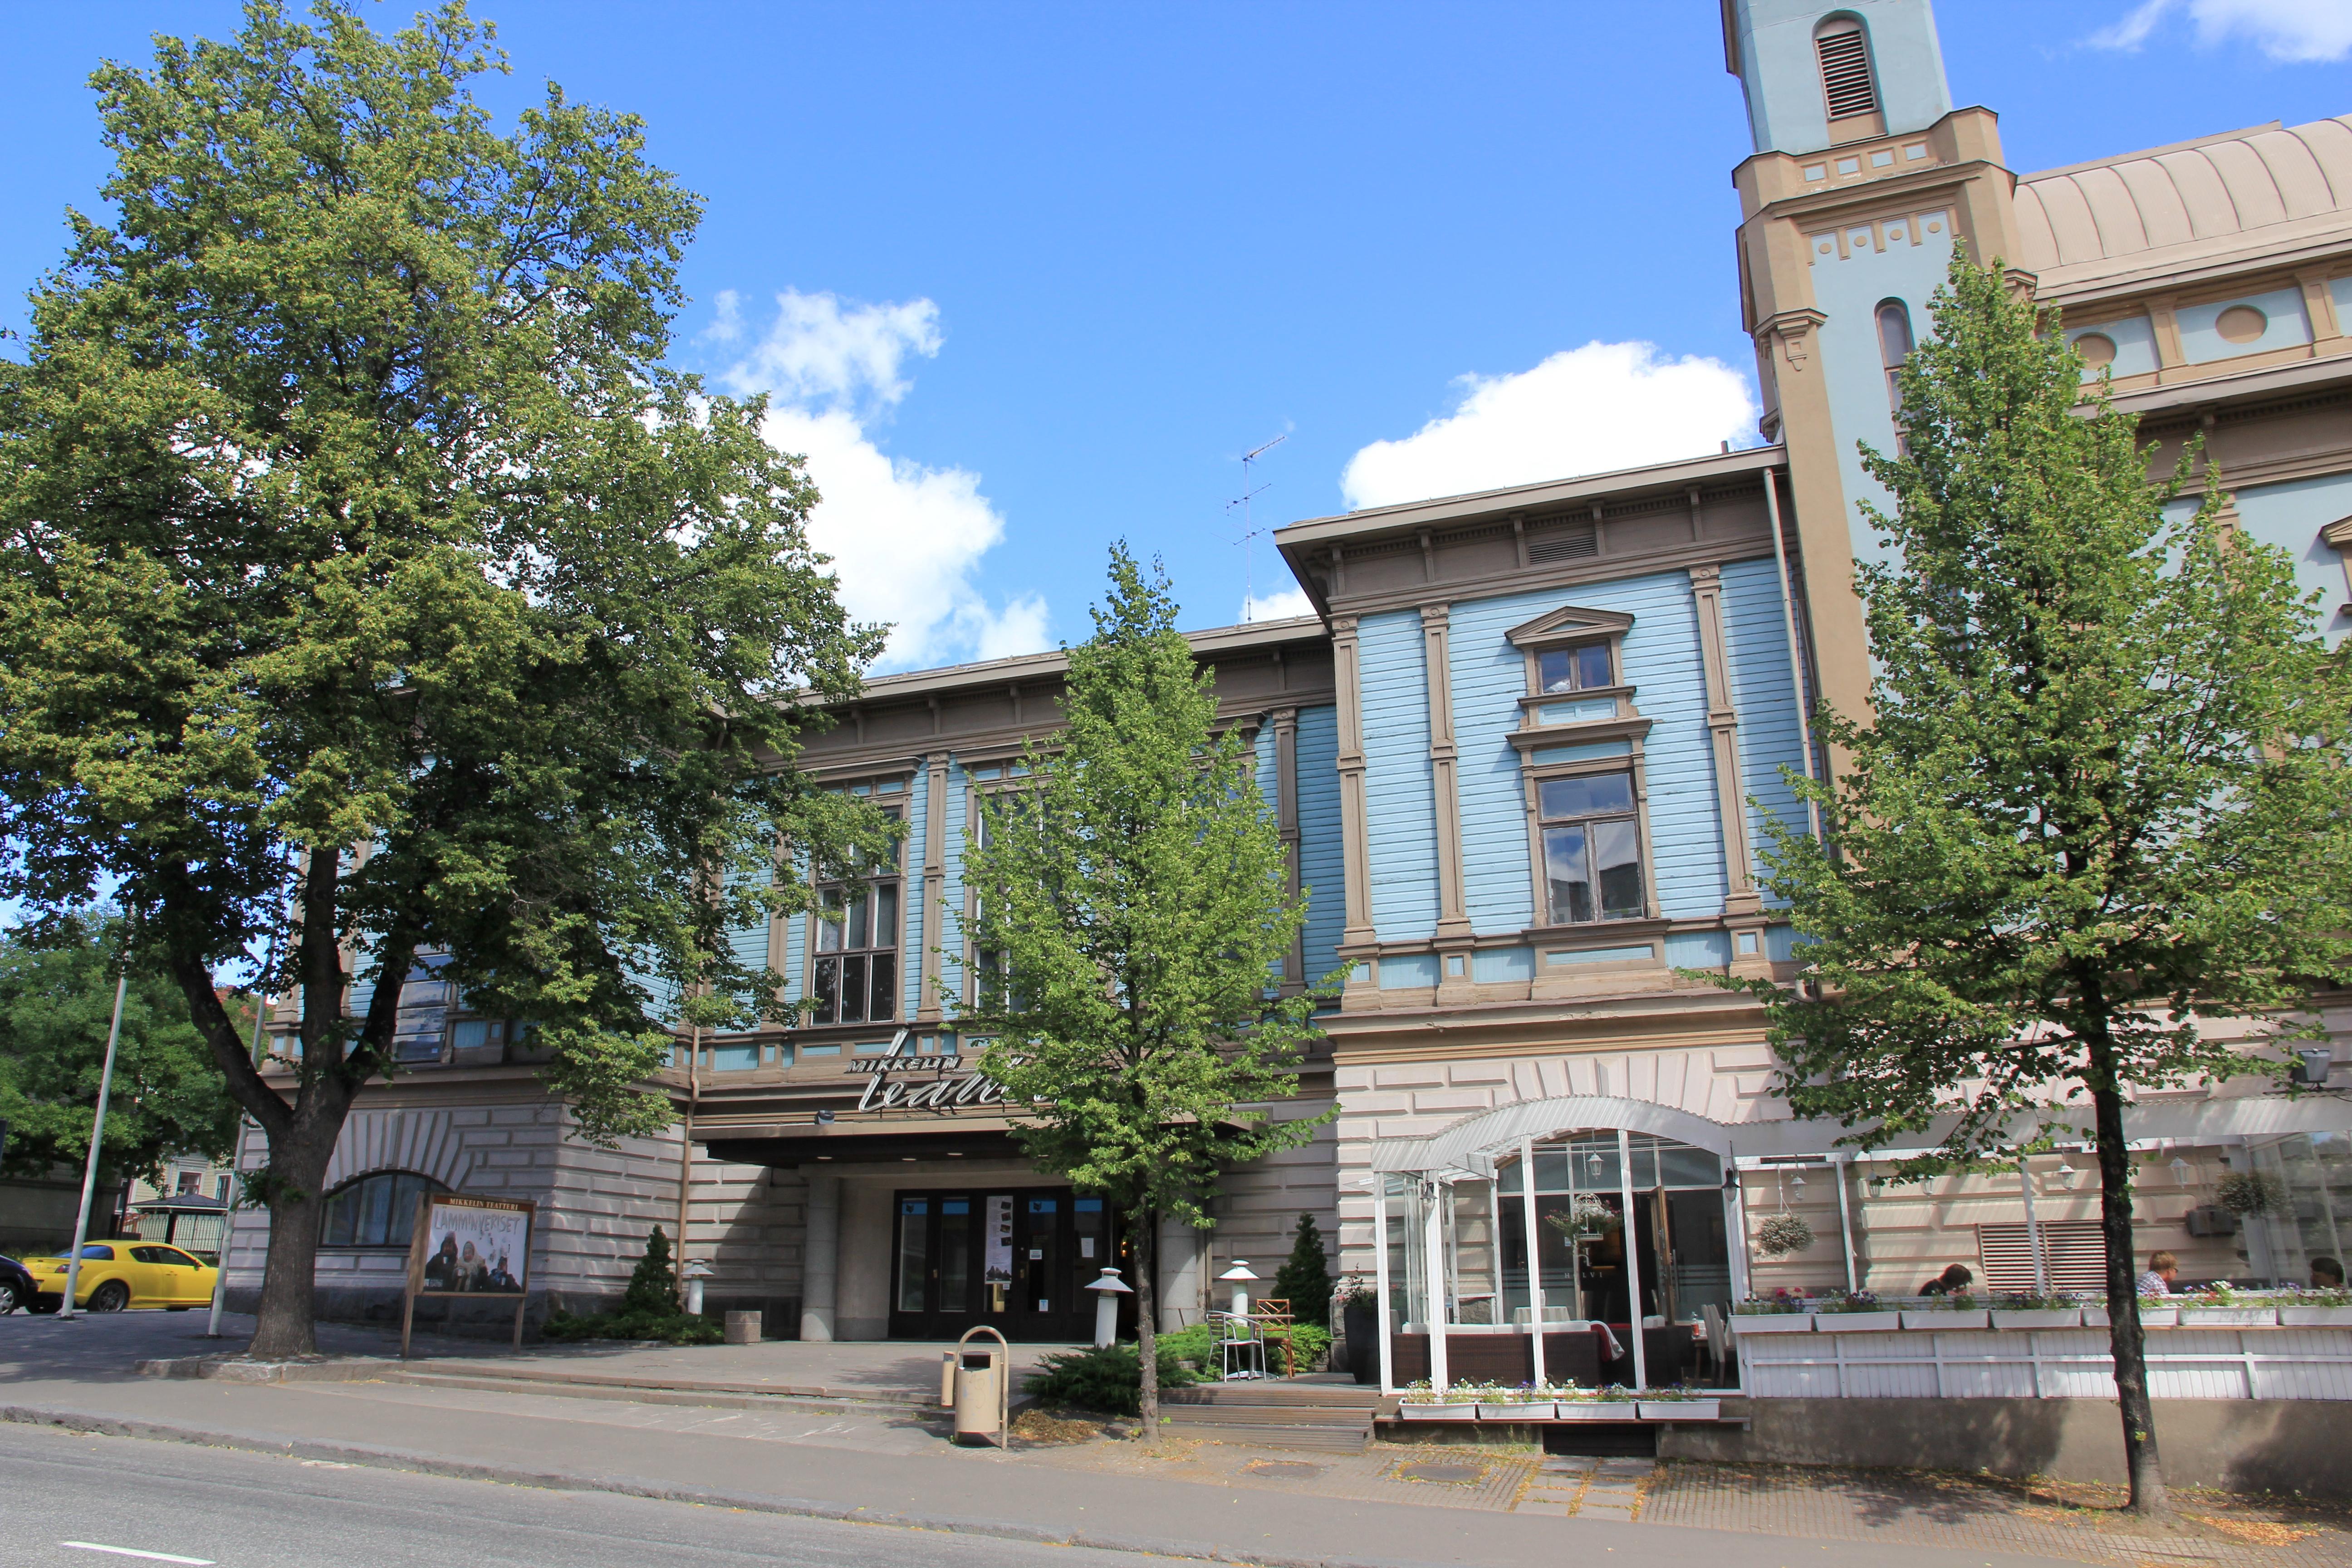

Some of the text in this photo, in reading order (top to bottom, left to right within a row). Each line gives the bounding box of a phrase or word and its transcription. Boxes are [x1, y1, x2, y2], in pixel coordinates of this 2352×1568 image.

[848, 1057, 960, 1073] MIKKELIN
[450, 1198, 519, 1211] MIKKELIN TEATTERI
[435, 1206, 521, 1235] LÄMMINVERISET
